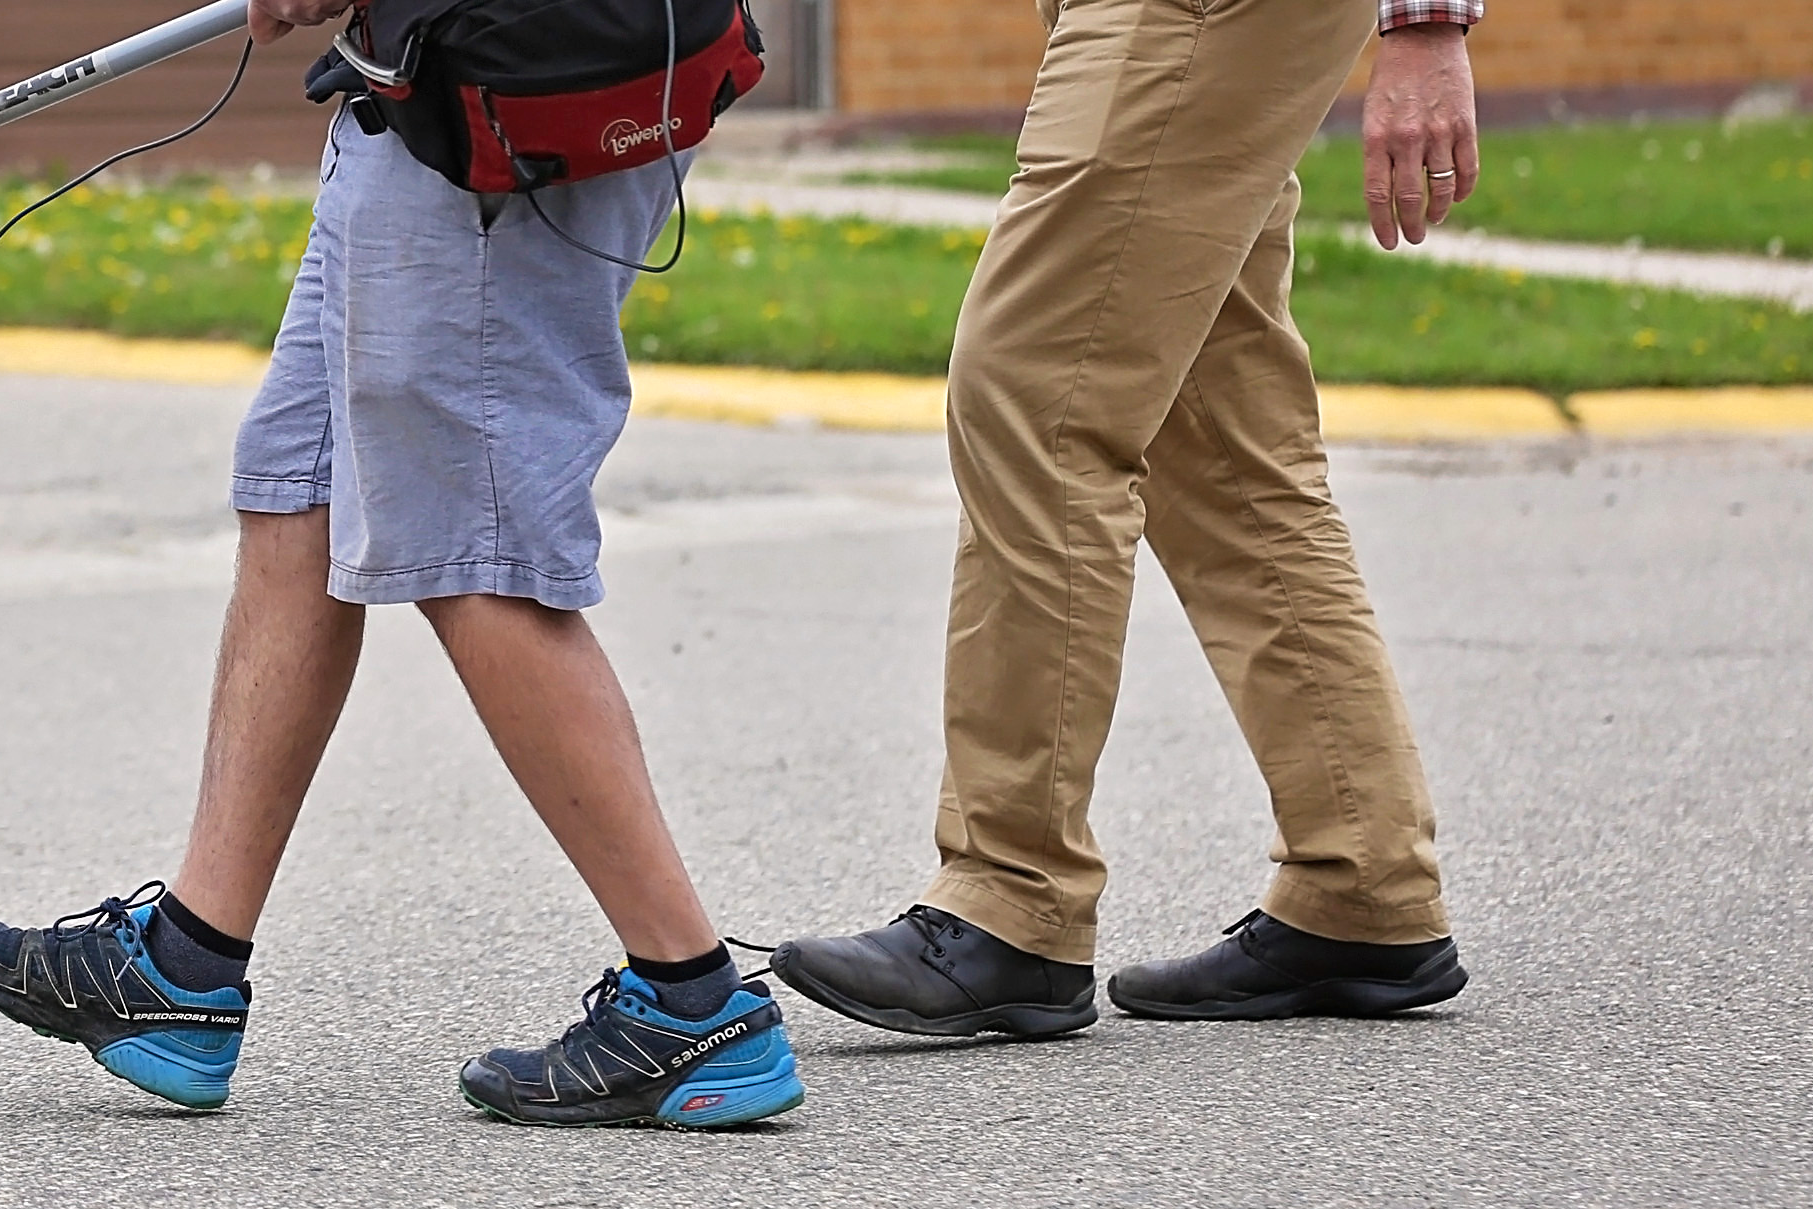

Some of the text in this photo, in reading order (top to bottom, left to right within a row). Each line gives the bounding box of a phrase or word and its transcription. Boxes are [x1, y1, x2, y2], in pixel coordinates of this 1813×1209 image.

[611, 117, 683, 157] Lowepo
[133, 1012, 241, 1024] SPEEDCROSS VARIO
